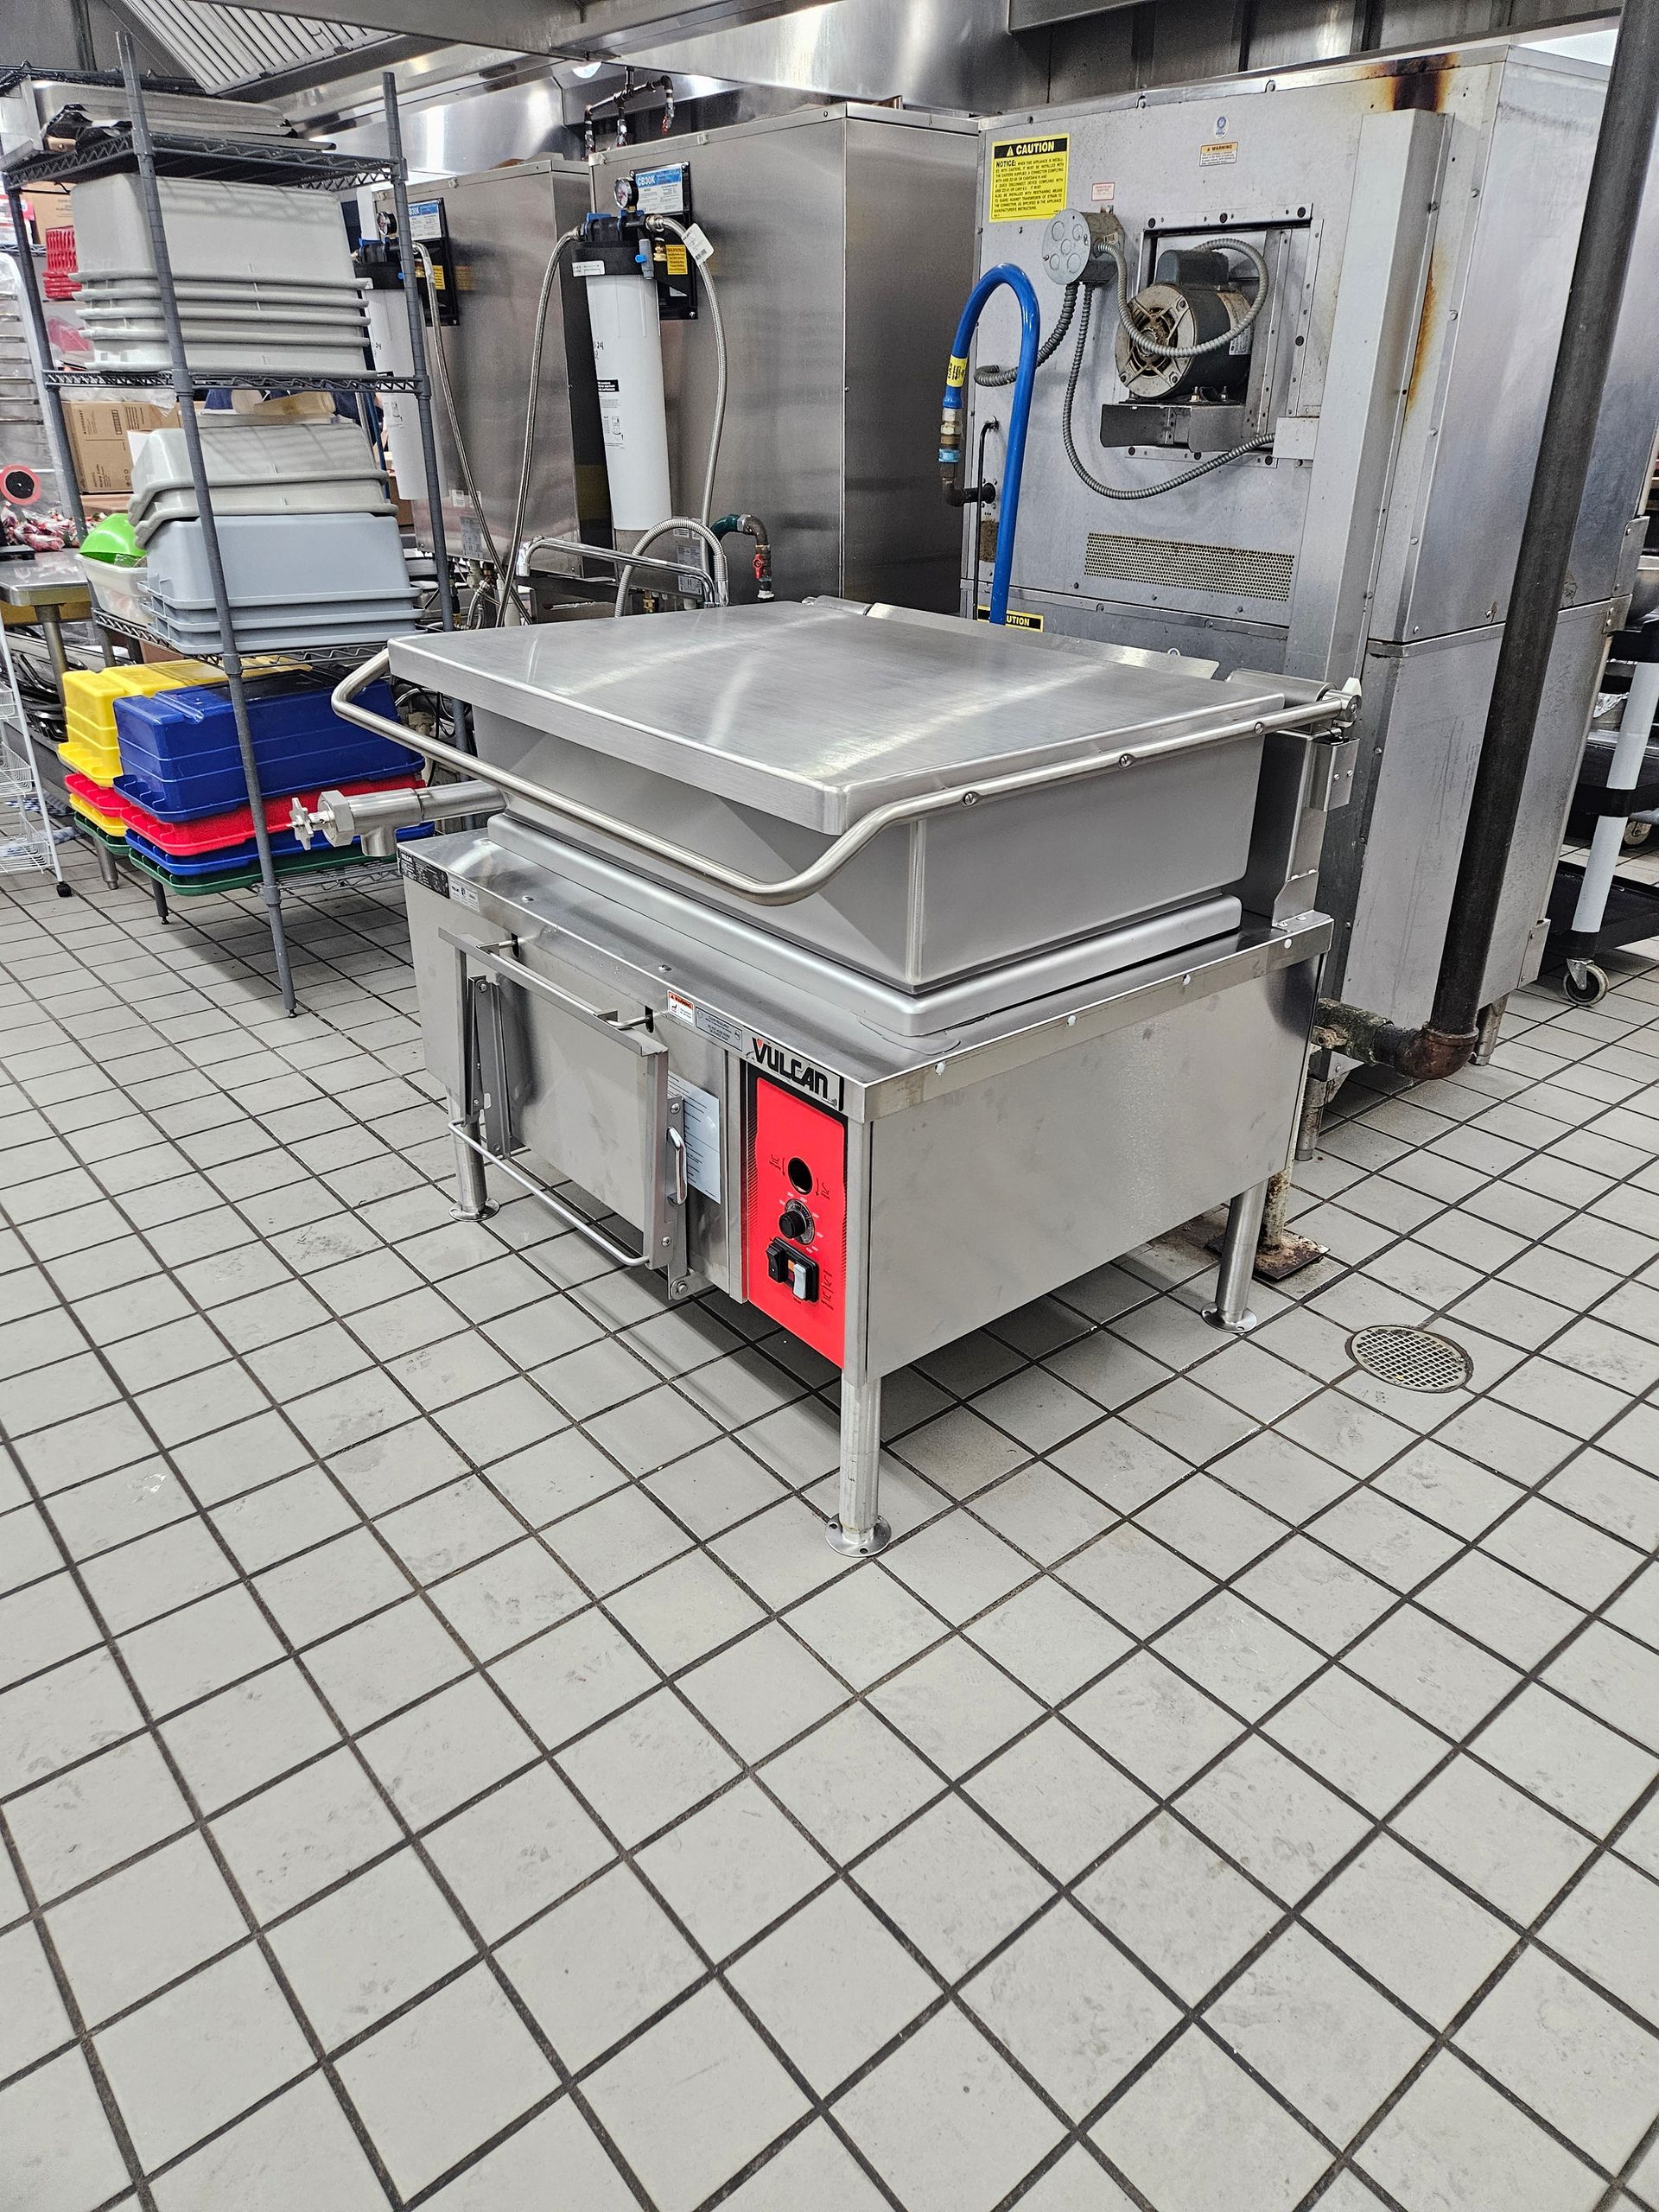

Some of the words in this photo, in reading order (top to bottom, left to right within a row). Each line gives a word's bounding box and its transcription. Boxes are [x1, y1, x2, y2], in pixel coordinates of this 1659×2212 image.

[1015, 140, 1054, 155] CAUTION
[996, 159, 1016, 168] NOTICE:
[1007, 616, 1030, 626] UTION
[752, 1037, 828, 1099] VULCAN
